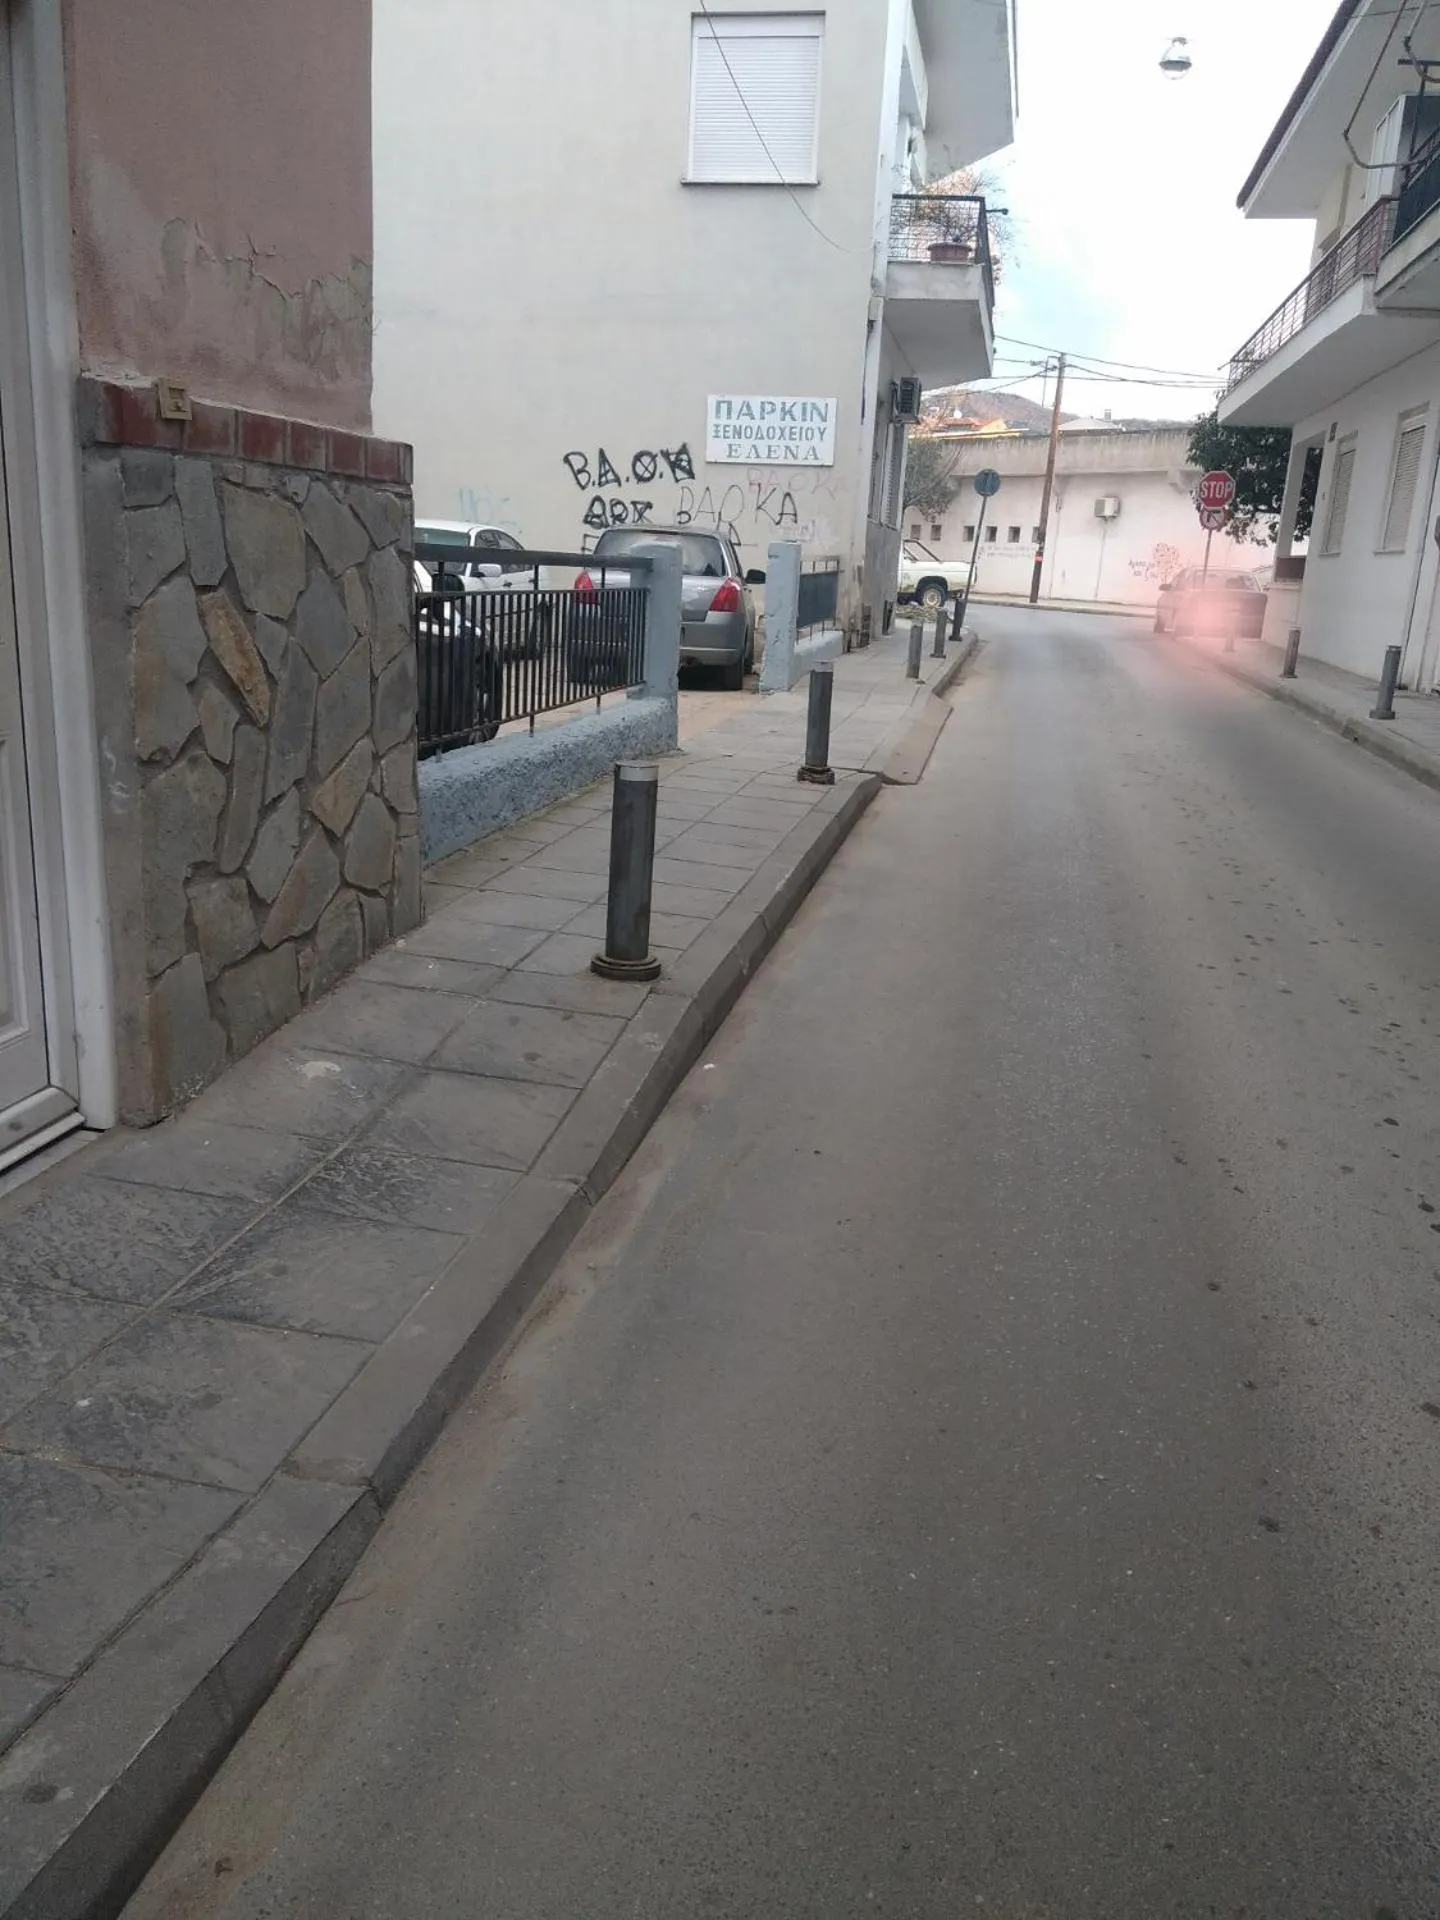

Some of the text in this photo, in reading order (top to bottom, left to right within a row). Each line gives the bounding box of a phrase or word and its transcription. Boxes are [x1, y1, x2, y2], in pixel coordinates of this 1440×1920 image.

[714, 399, 829, 423] ΠΑΡΚΙΝ
[712, 423, 828, 441] ΞΕΝΟΔΟΧΕΙΟΥ
[725, 443, 821, 461] ΕΛΕΝΑ
[1200, 480, 1233, 499] STOP
